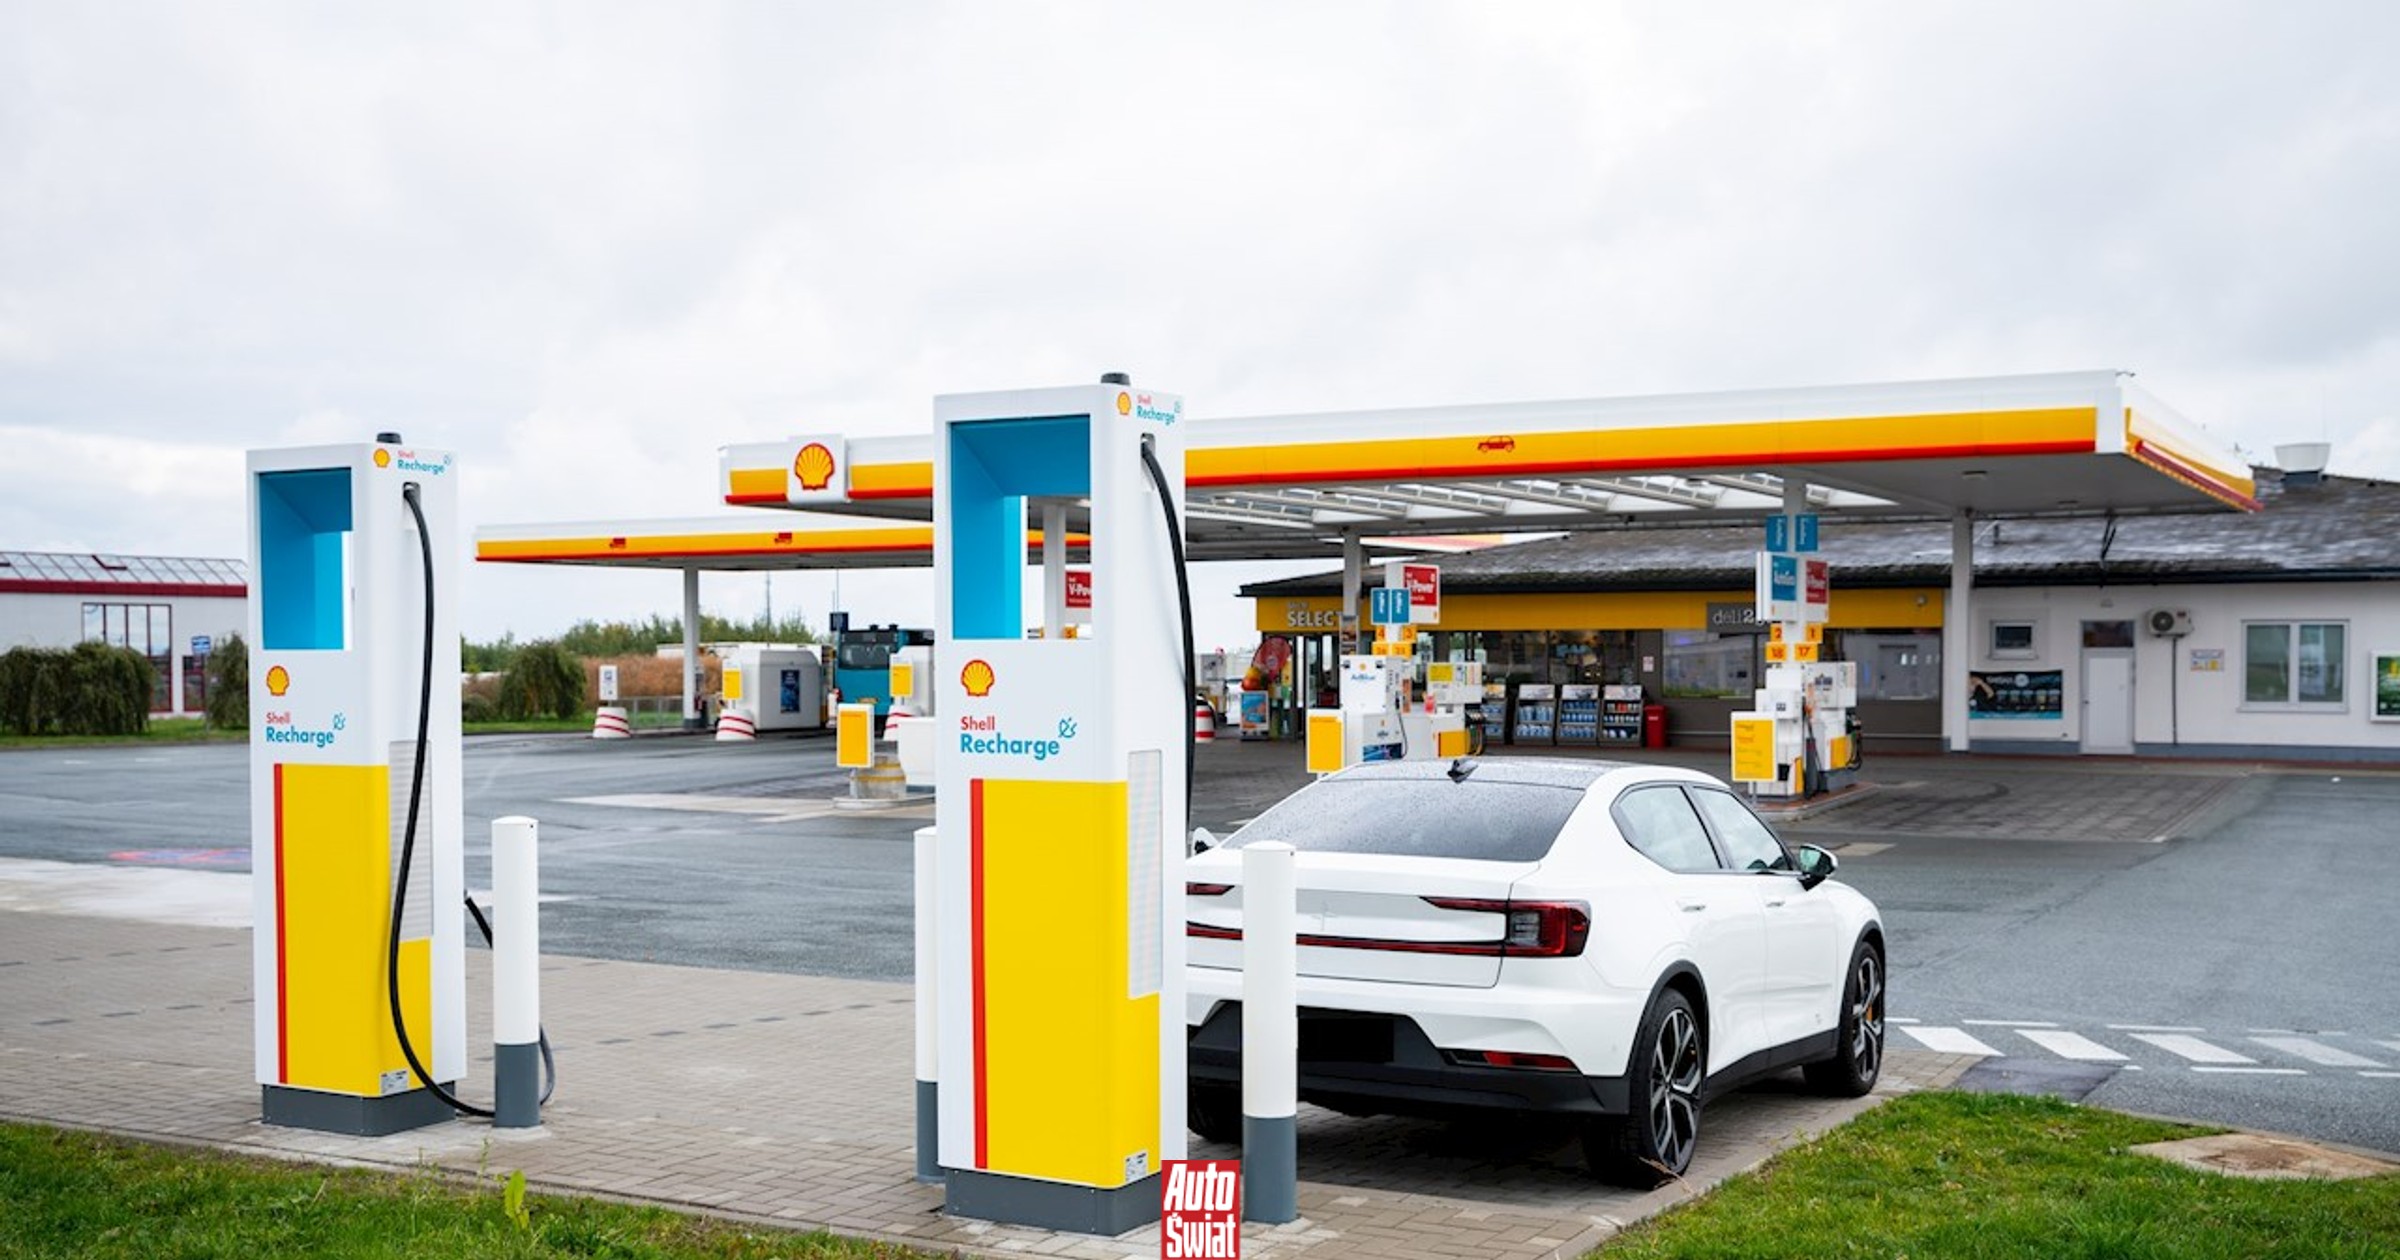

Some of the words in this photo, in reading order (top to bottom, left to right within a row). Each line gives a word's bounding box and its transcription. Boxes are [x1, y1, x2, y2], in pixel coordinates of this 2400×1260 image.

[1136, 405, 1175, 426] Recharge
[397, 459, 445, 475] Recharge
[1798, 645, 1811, 658] 17
[266, 712, 292, 724] Shell
[960, 715, 996, 731] Shell
[266, 725, 335, 748] Recharge
[960, 732, 1061, 761] Recharge
